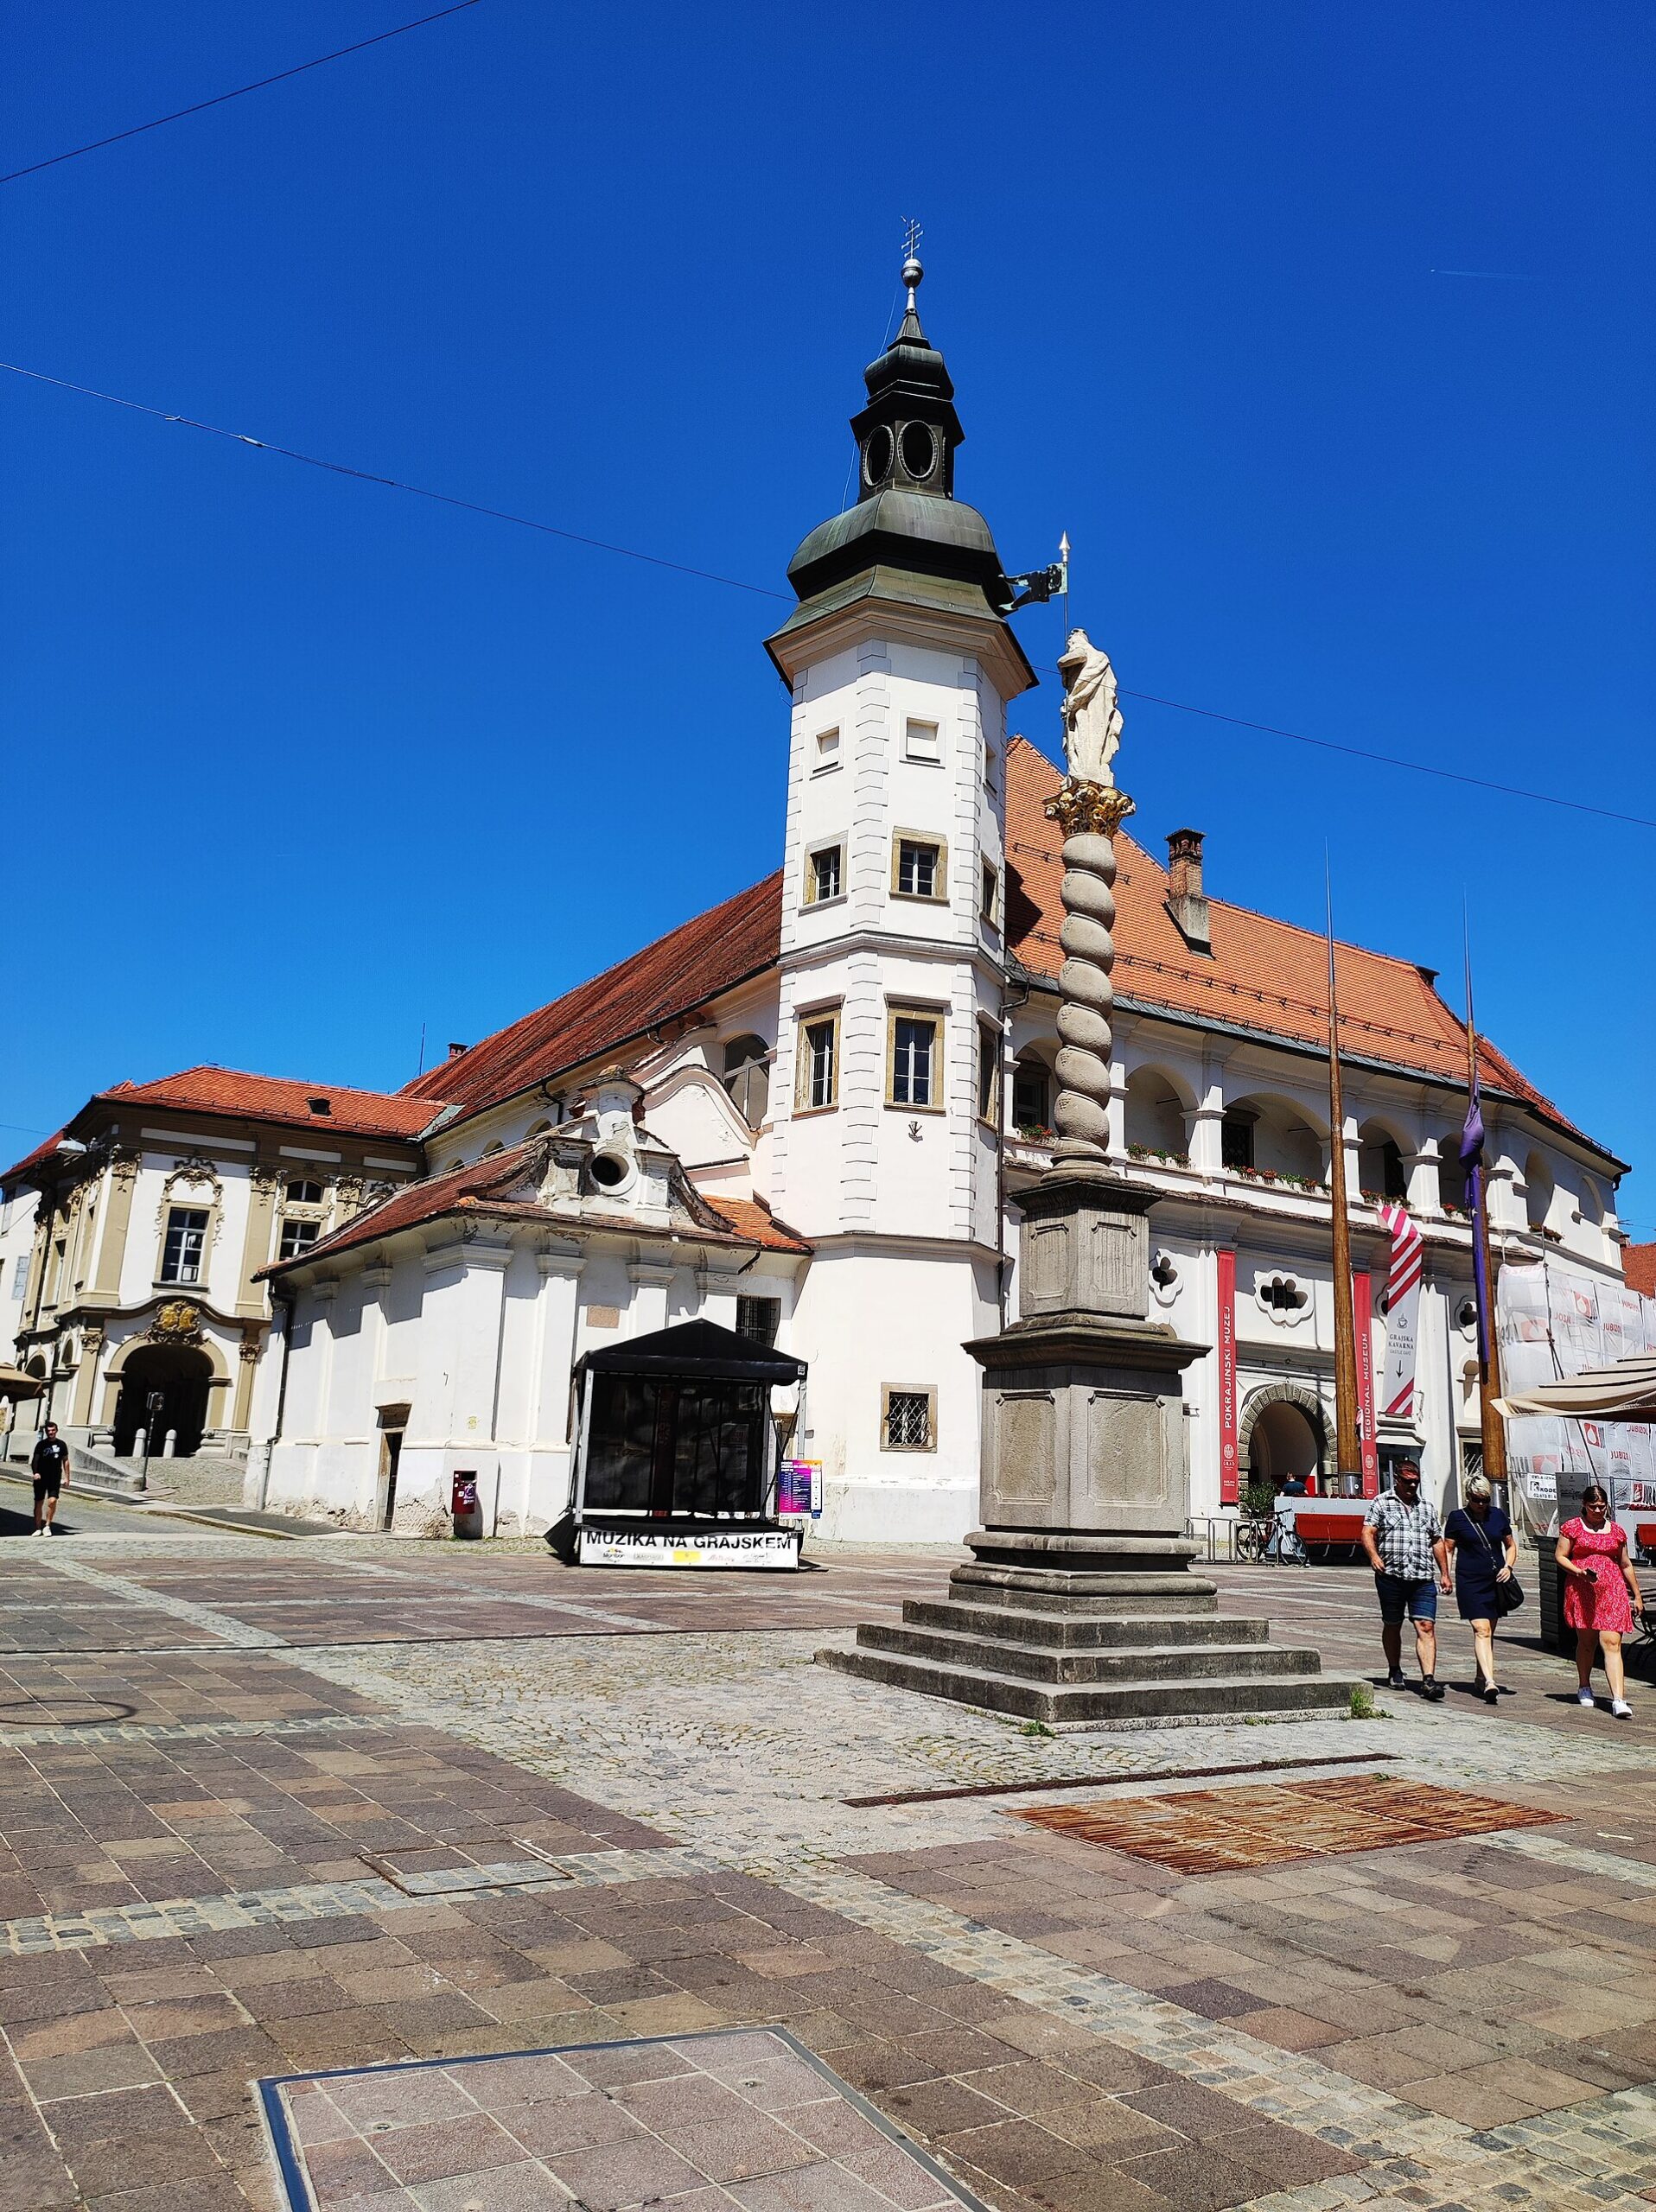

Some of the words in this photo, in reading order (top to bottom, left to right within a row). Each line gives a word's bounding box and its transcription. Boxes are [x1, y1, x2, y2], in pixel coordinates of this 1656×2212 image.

[1362, 1333, 1371, 1380] MUSEUM
[1388, 1341, 1414, 1350] KAVARNA
[1224, 1349, 1232, 1429] POKRAJINSKI
[586, 1531, 657, 1547] MUZIKA
[663, 1536, 687, 1548] NA
[694, 1536, 791, 1549] GRAJSKEM
